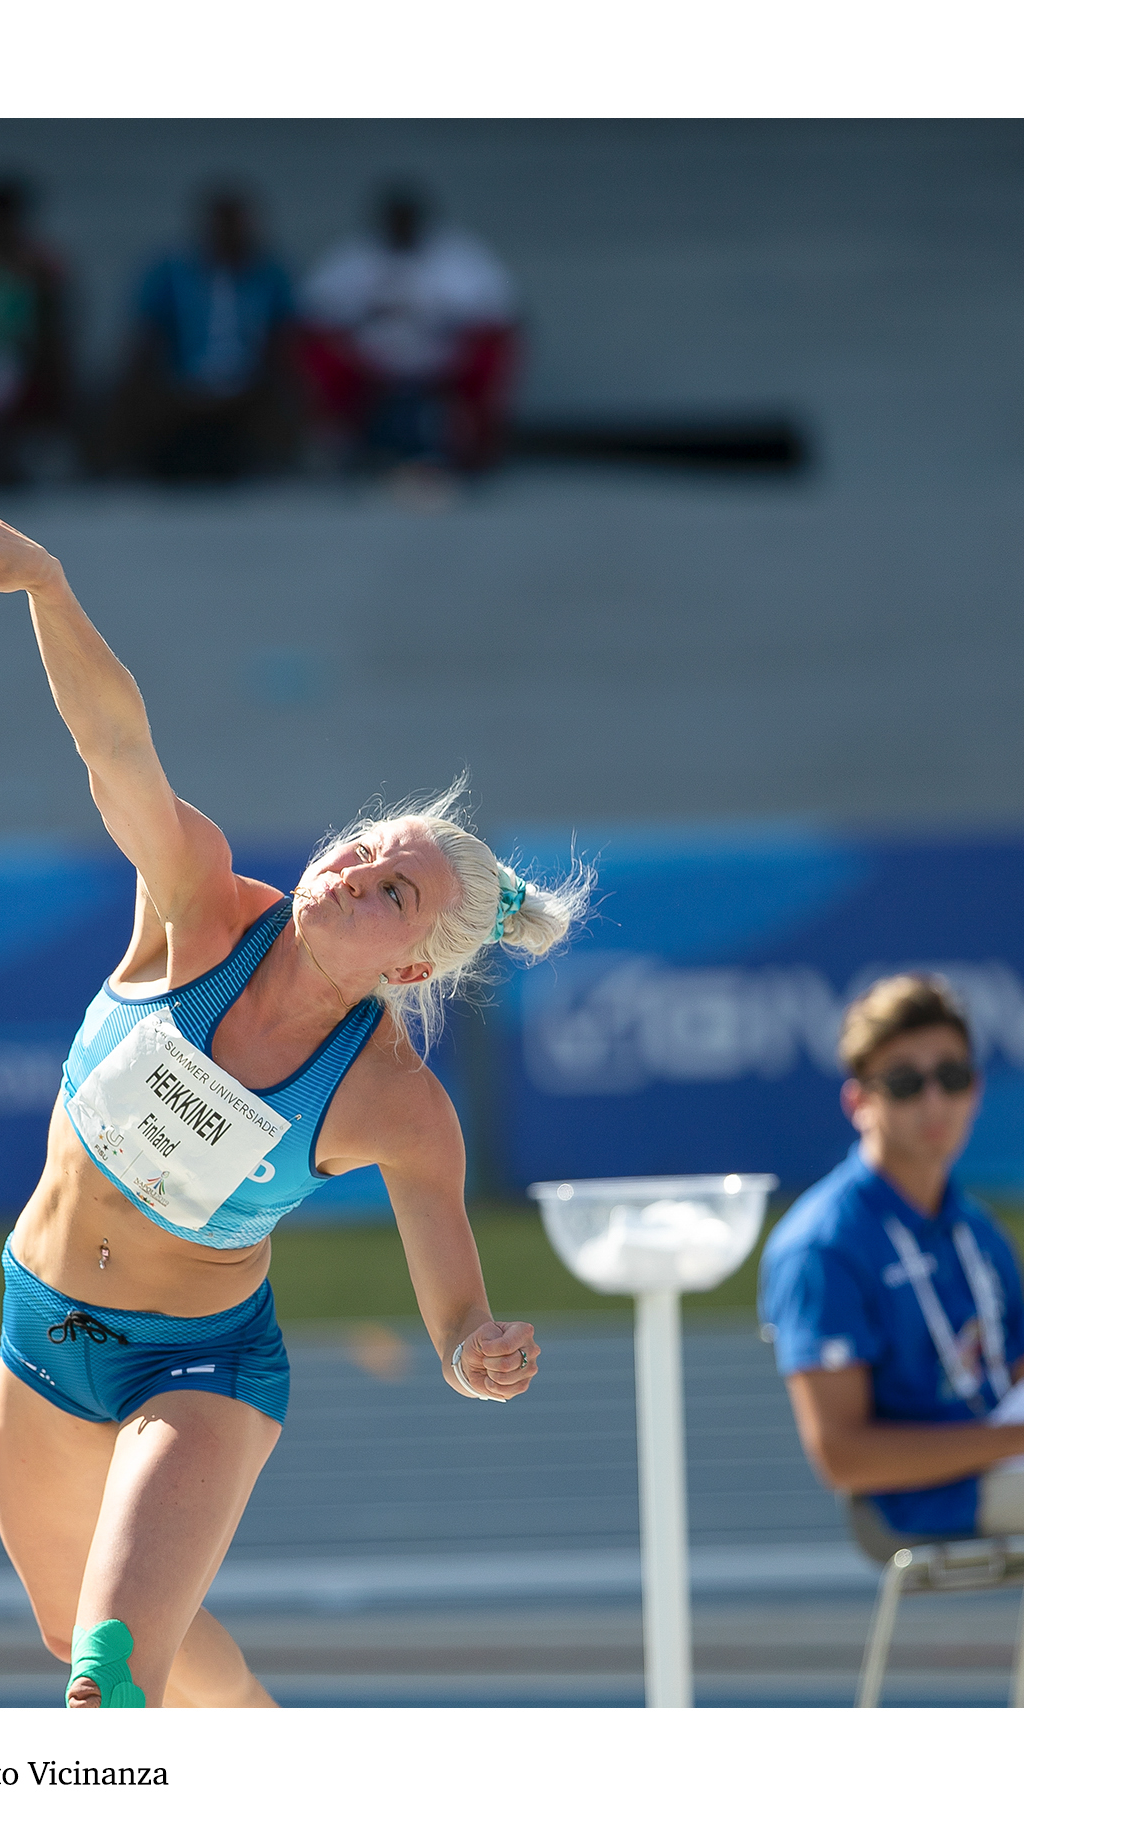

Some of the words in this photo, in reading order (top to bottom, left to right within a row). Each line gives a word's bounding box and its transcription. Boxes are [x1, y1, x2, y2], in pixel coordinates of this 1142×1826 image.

[145, 1063, 232, 1146] HEIKKINEN
[165, 1040, 209, 1085] SUMMER
[209, 1079, 278, 1138] UNIVERSIADE
[94, 1144, 109, 1161] FISU
[137, 1112, 181, 1158] Finland
